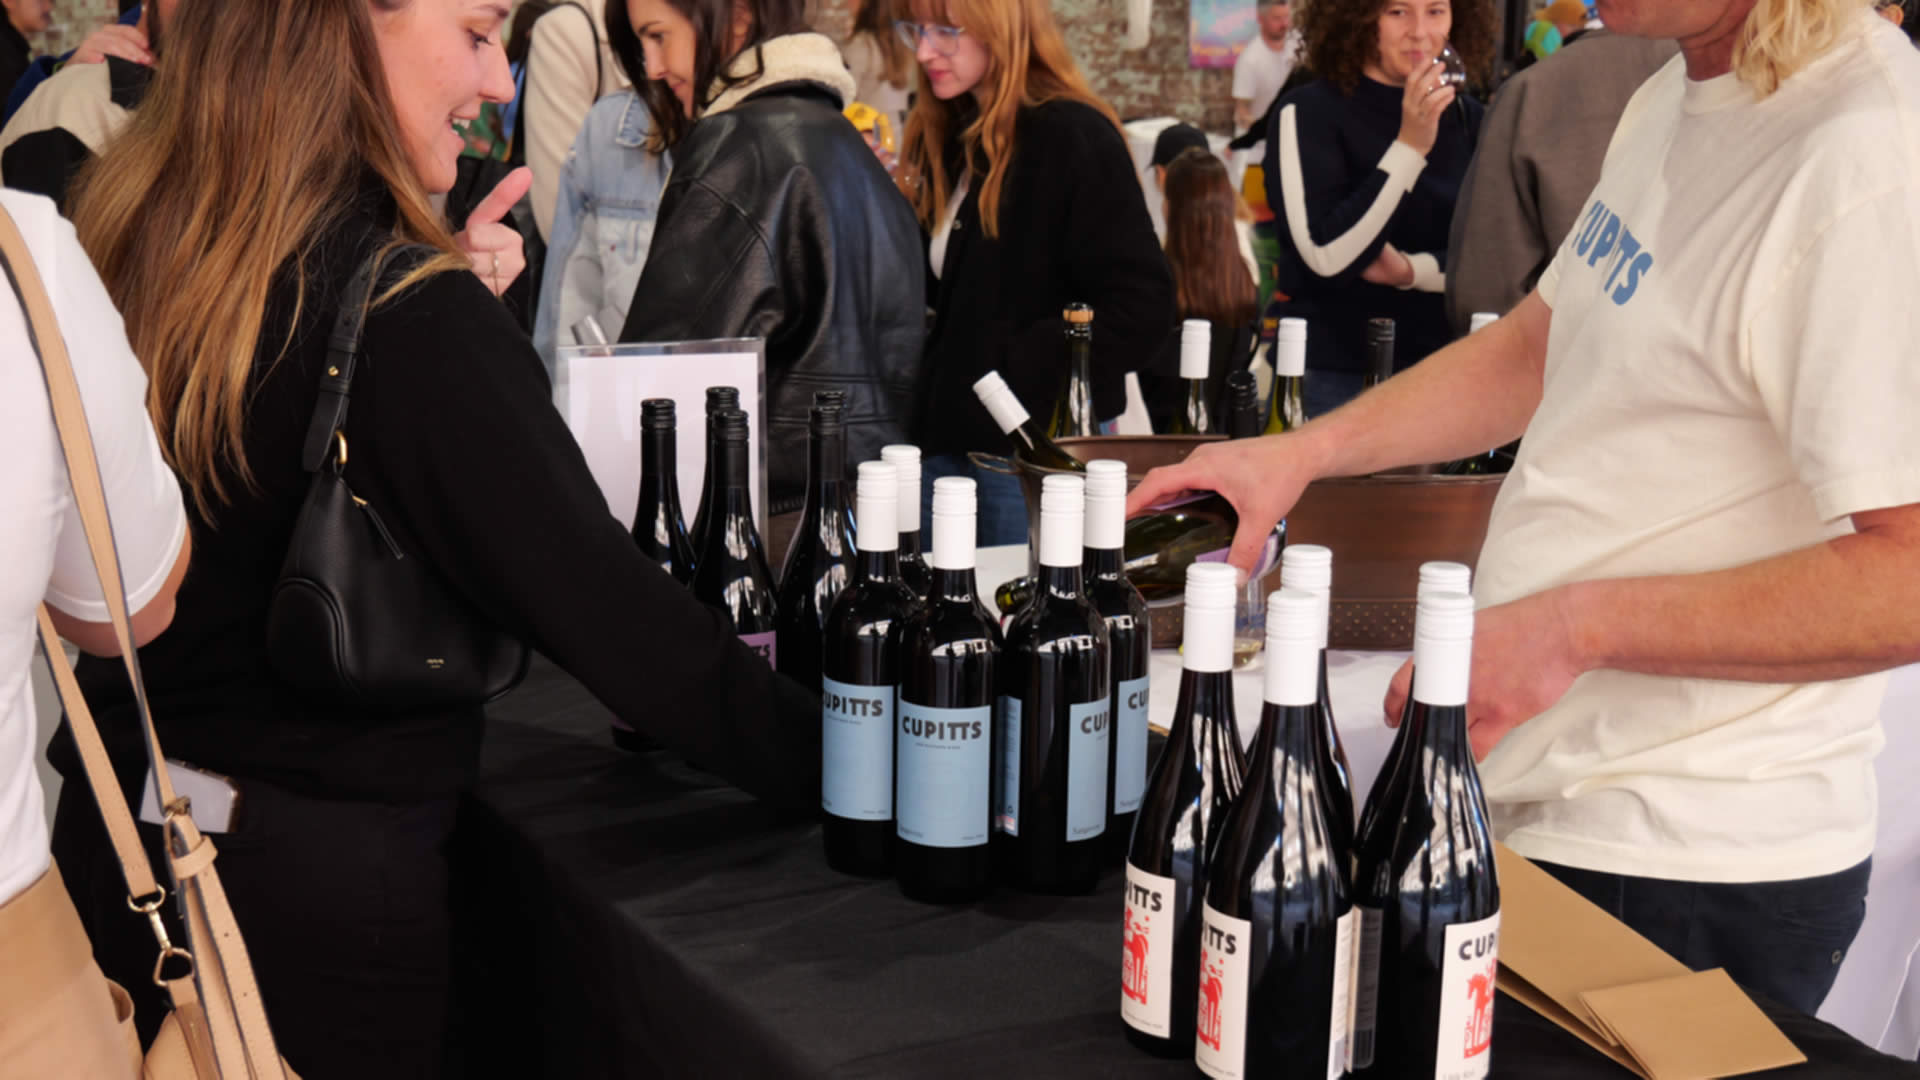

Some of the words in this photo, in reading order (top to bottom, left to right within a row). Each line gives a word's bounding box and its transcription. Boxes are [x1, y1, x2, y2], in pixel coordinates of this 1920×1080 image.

[823, 691, 883, 717] UPITTS
[902, 716, 982, 740] CUPITTS
[1123, 880, 1162, 912] ITTS
[1202, 921, 1237, 955] ITTS
